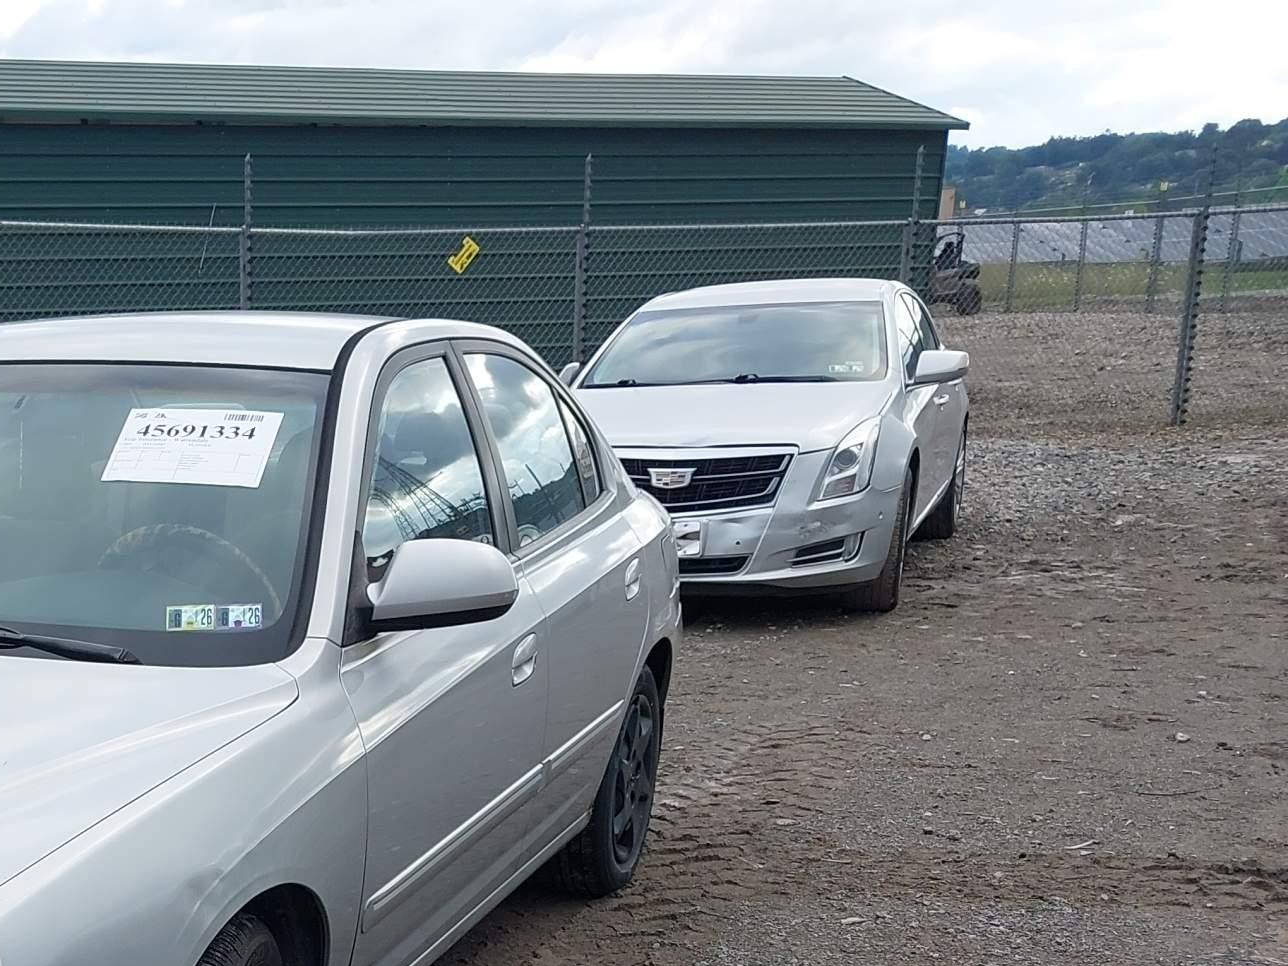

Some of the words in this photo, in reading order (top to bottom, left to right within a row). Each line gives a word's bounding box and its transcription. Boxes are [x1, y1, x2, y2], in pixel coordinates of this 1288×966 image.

[136, 423, 257, 440] 45691334
[200, 608, 212, 625] 26
[248, 607, 260, 624] 26
